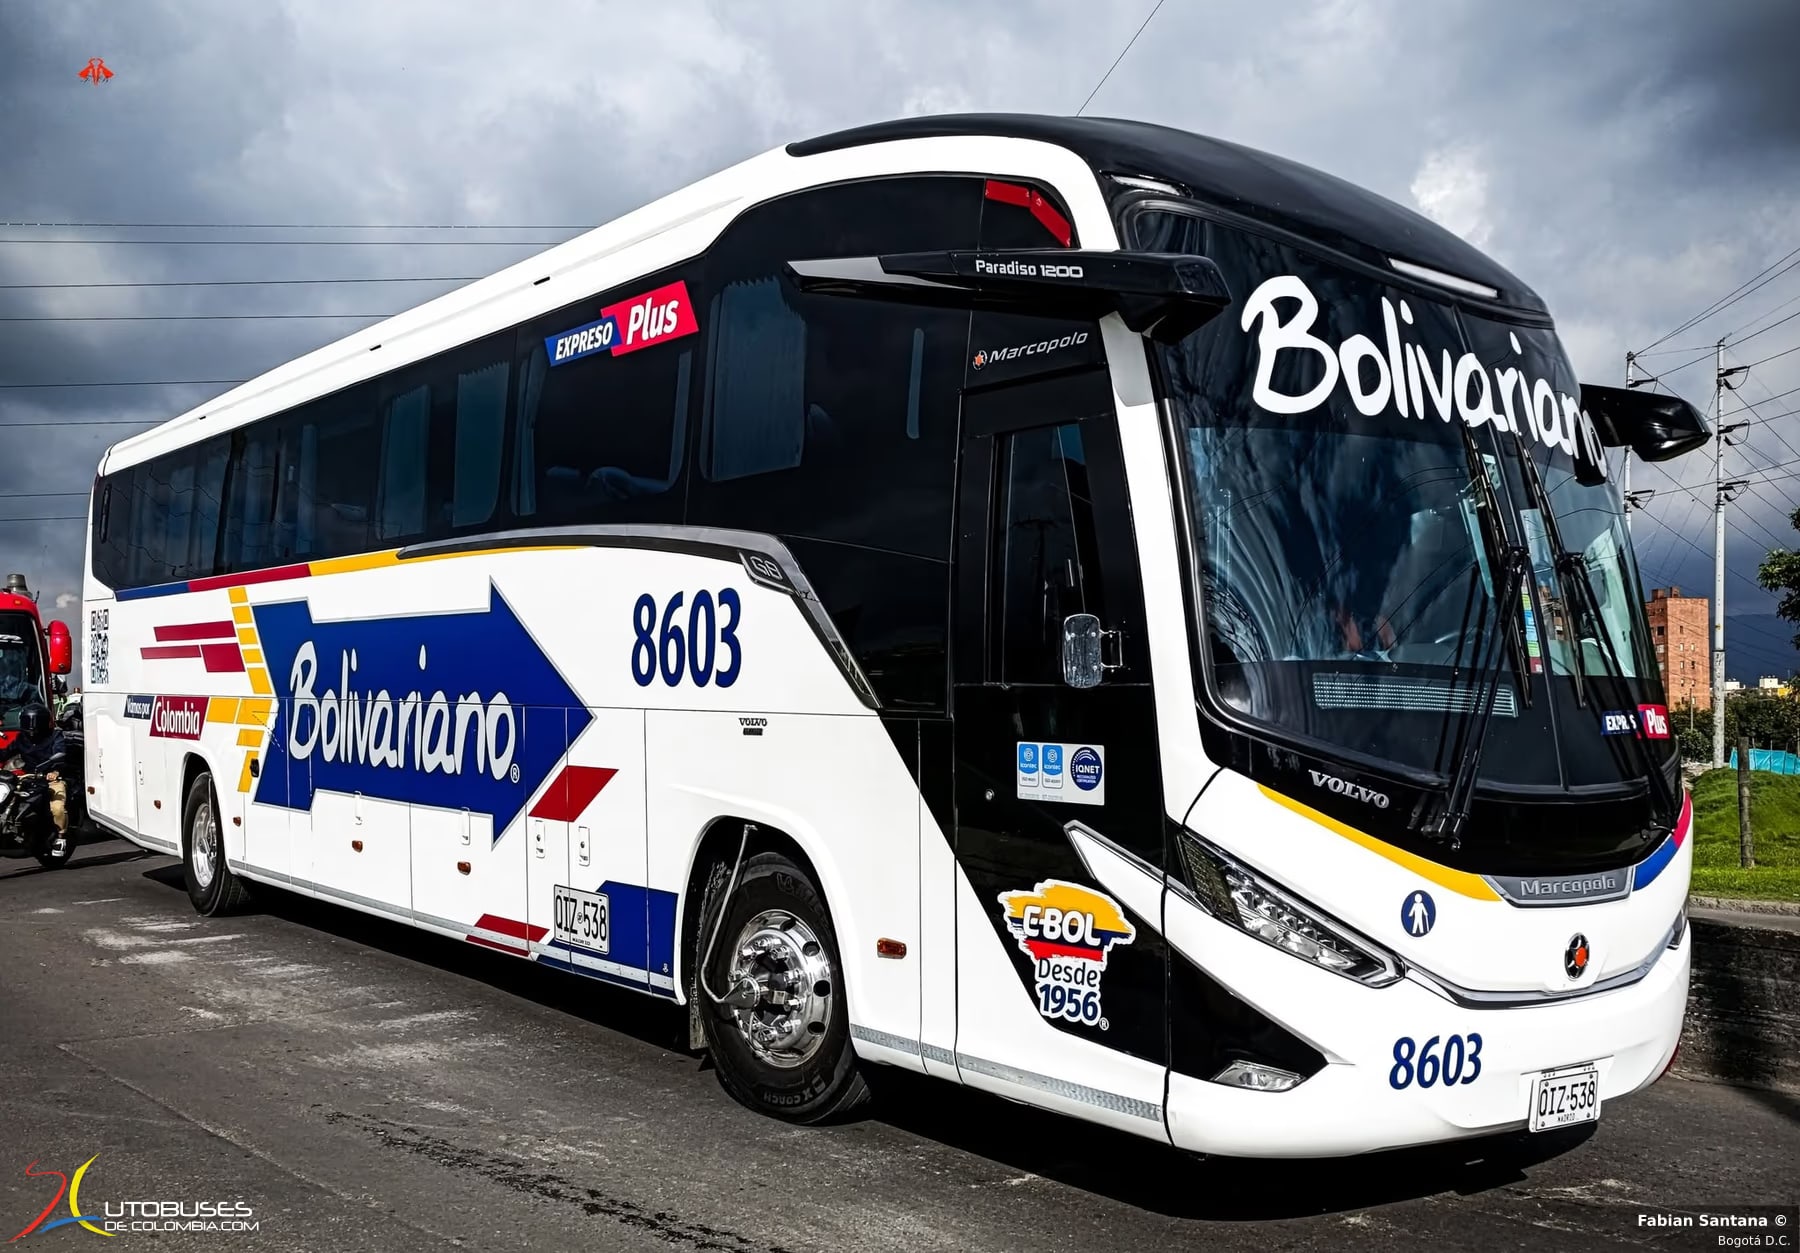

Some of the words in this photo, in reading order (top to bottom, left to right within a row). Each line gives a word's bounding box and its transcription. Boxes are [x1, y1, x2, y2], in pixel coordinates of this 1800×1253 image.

[976, 260, 1037, 276] Paradiso
[1040, 264, 1083, 278] 1200
[555, 321, 613, 361] EXPRESO
[626, 297, 679, 346] Plus
[989, 332, 1088, 363] Marcopolo
[1241, 275, 1608, 478] Bolivariano
[631, 587, 742, 688] 8603
[155, 700, 200, 735] Colombia
[290, 641, 516, 780] Bolivariano
[738, 717, 768, 727] VOLVO
[1646, 707, 1668, 735] Plus
[1075, 765, 1100, 774] IQNET
[1308, 769, 1390, 809] VOLVO
[1520, 874, 1617, 896] Marcopolo
[1038, 958, 1098, 988] Desde
[1039, 983, 1099, 1022] 1956
[1389, 1032, 1483, 1091] 8603
